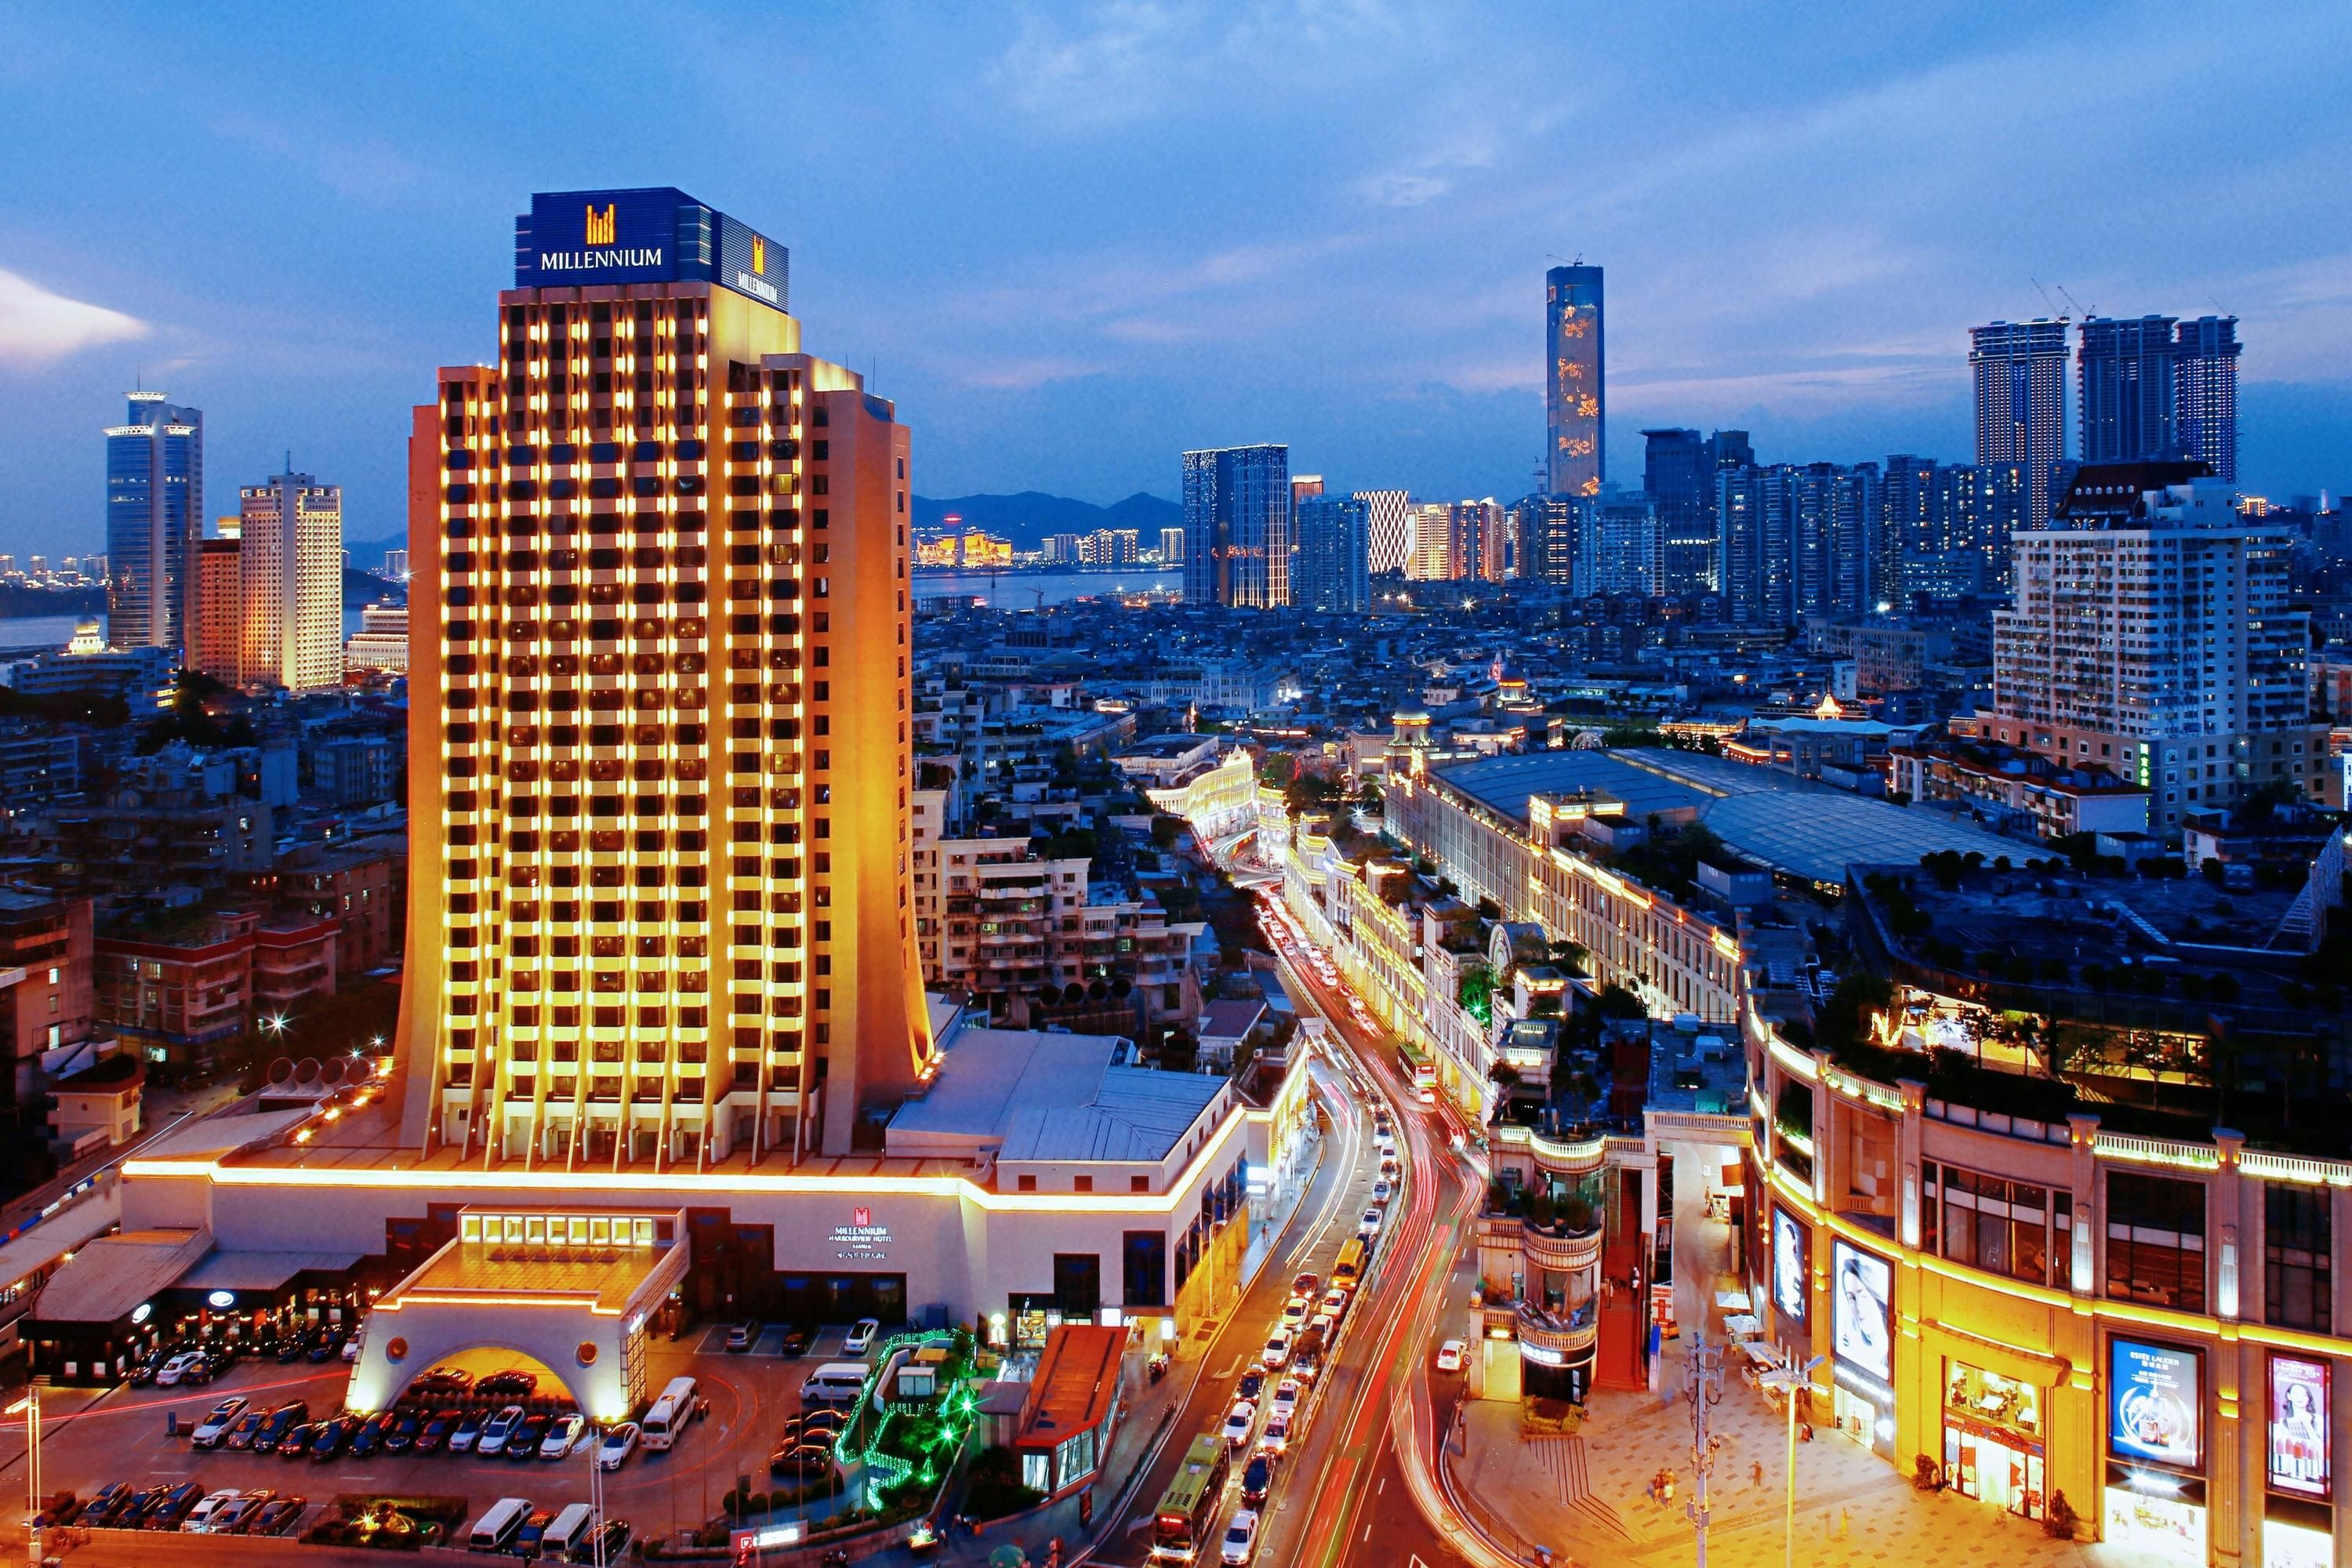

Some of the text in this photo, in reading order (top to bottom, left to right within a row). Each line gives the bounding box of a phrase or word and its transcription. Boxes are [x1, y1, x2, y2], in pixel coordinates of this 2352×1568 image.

[541, 248, 662, 270] MILLENNIUM
[738, 270, 777, 304] MILLENNIUM
[835, 1227, 887, 1236] MILLENNIUM
[2151, 1356, 2180, 1367] LAUDER
